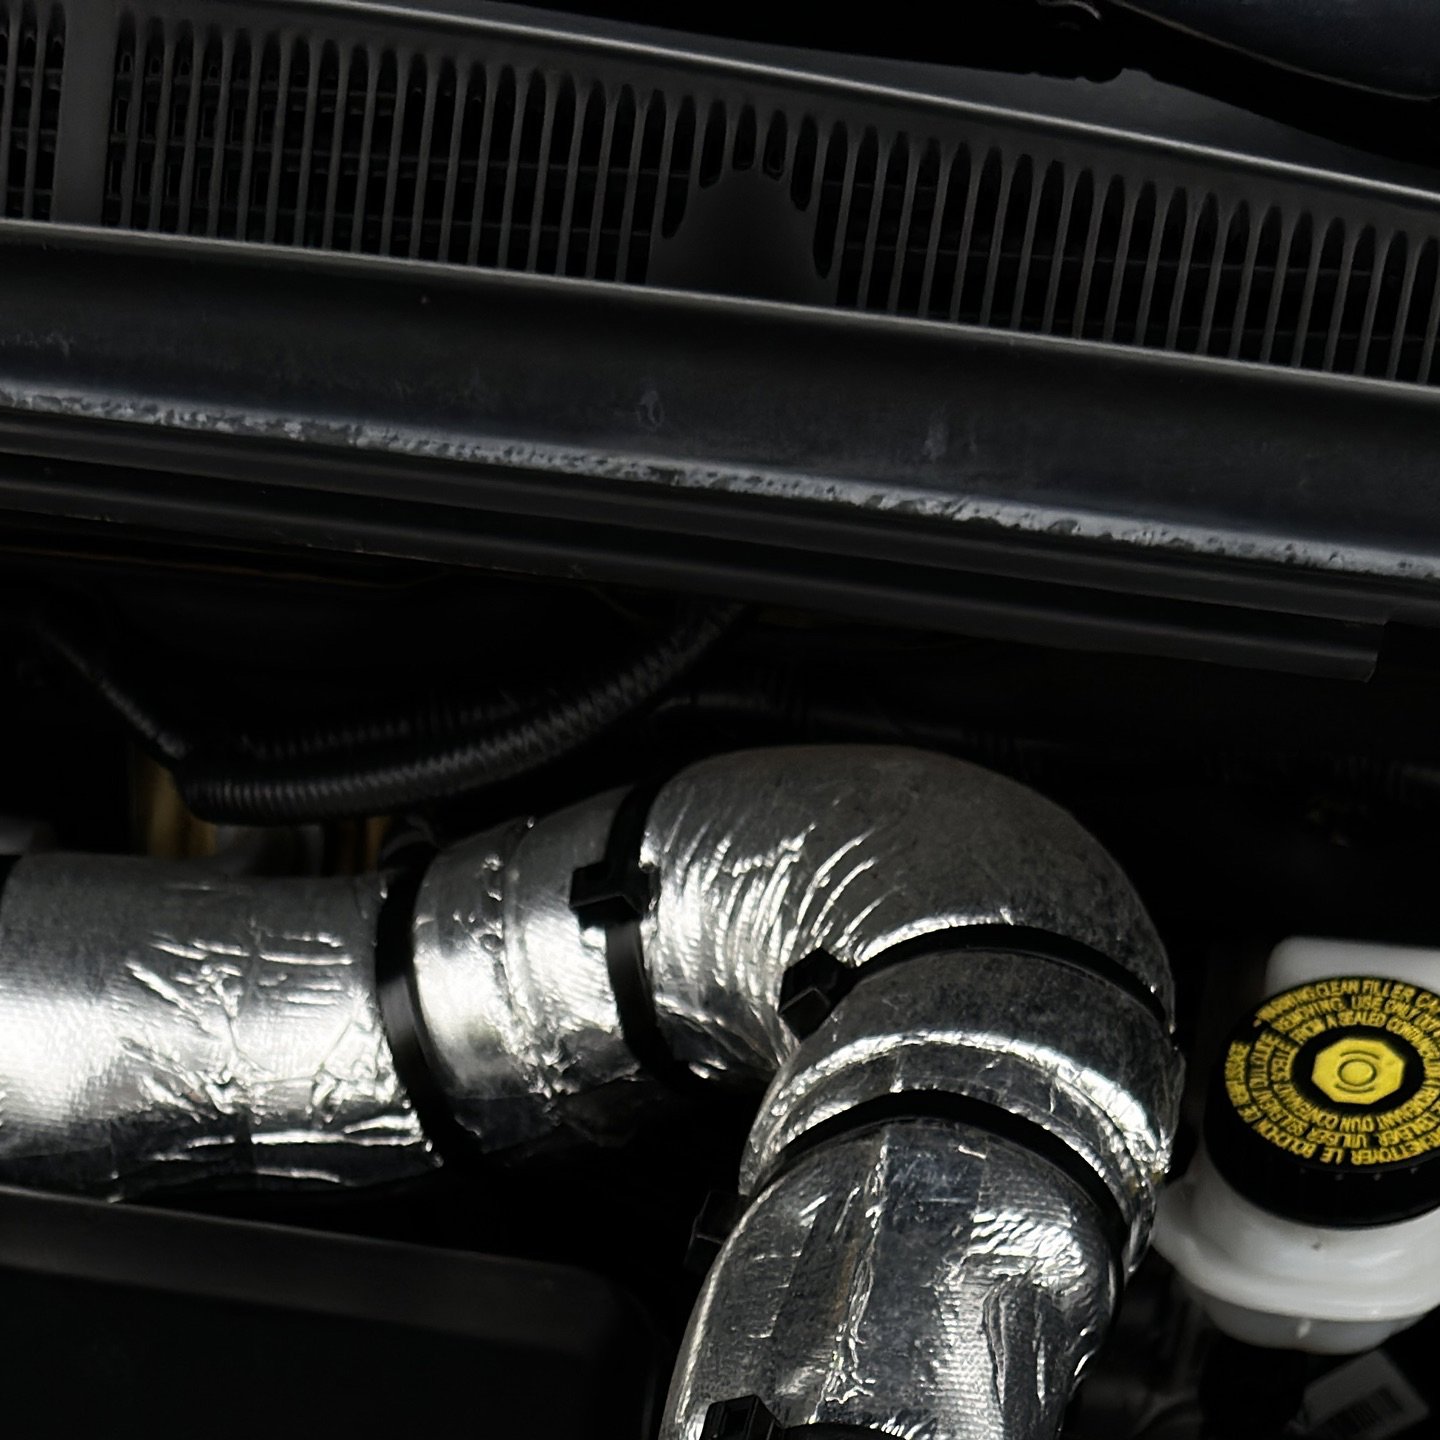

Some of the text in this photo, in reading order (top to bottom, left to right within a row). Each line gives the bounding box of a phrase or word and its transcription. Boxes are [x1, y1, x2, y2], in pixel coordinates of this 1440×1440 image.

[1314, 978, 1360, 997] CLEAN
[1361, 978, 1418, 1002] FILLER
[1334, 1009, 1389, 1028] SEALED
[1316, 1147, 1344, 1165] LE
